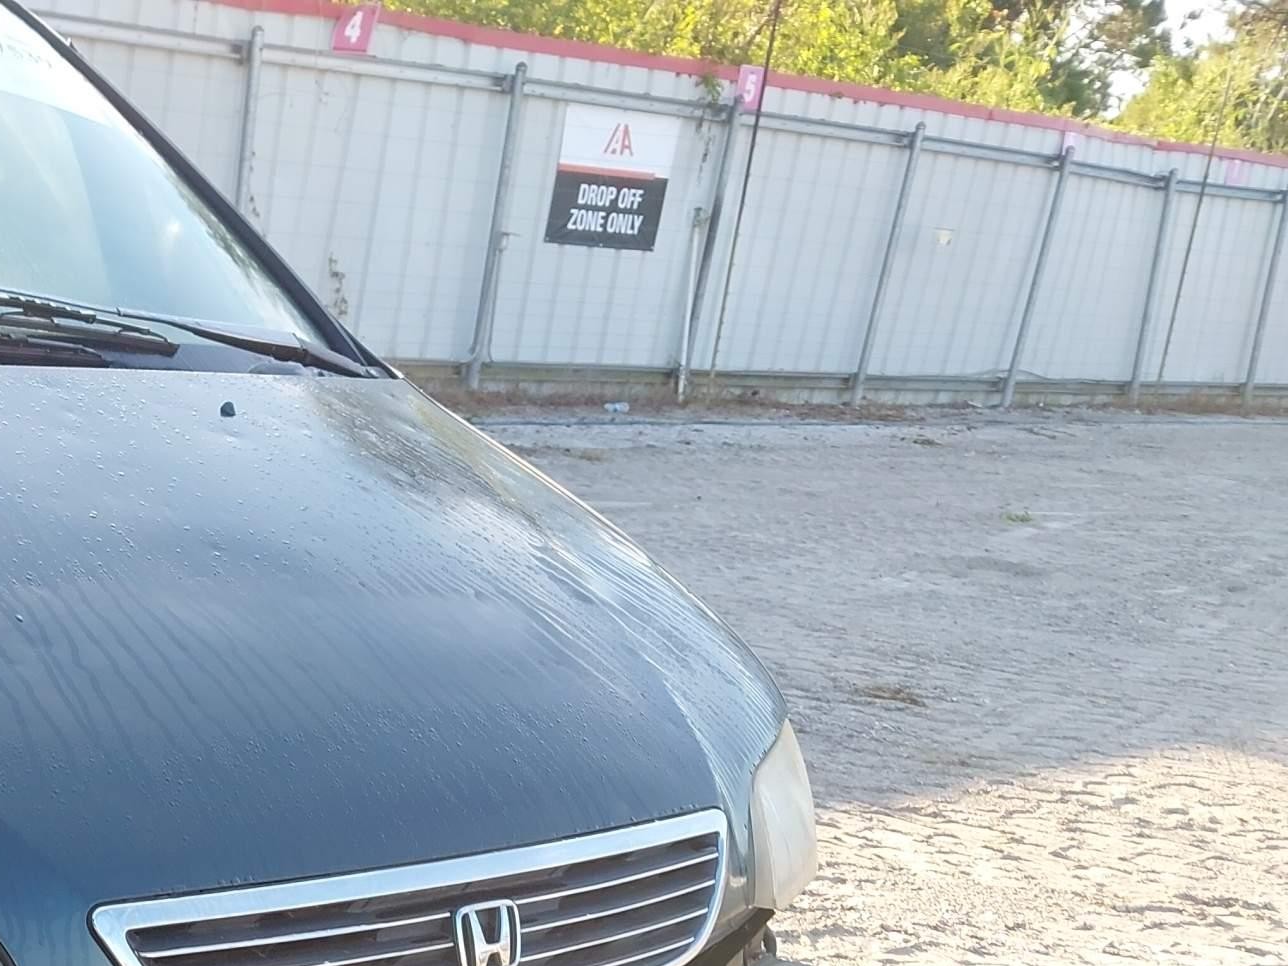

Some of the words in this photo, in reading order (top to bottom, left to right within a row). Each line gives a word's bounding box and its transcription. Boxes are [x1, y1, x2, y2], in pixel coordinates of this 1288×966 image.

[344, 11, 363, 43] 4
[743, 74, 757, 102] 5
[577, 183, 617, 207] DROP
[617, 187, 645, 210] OFF
[566, 208, 607, 232] ZONE
[606, 212, 643, 235] ONLY
